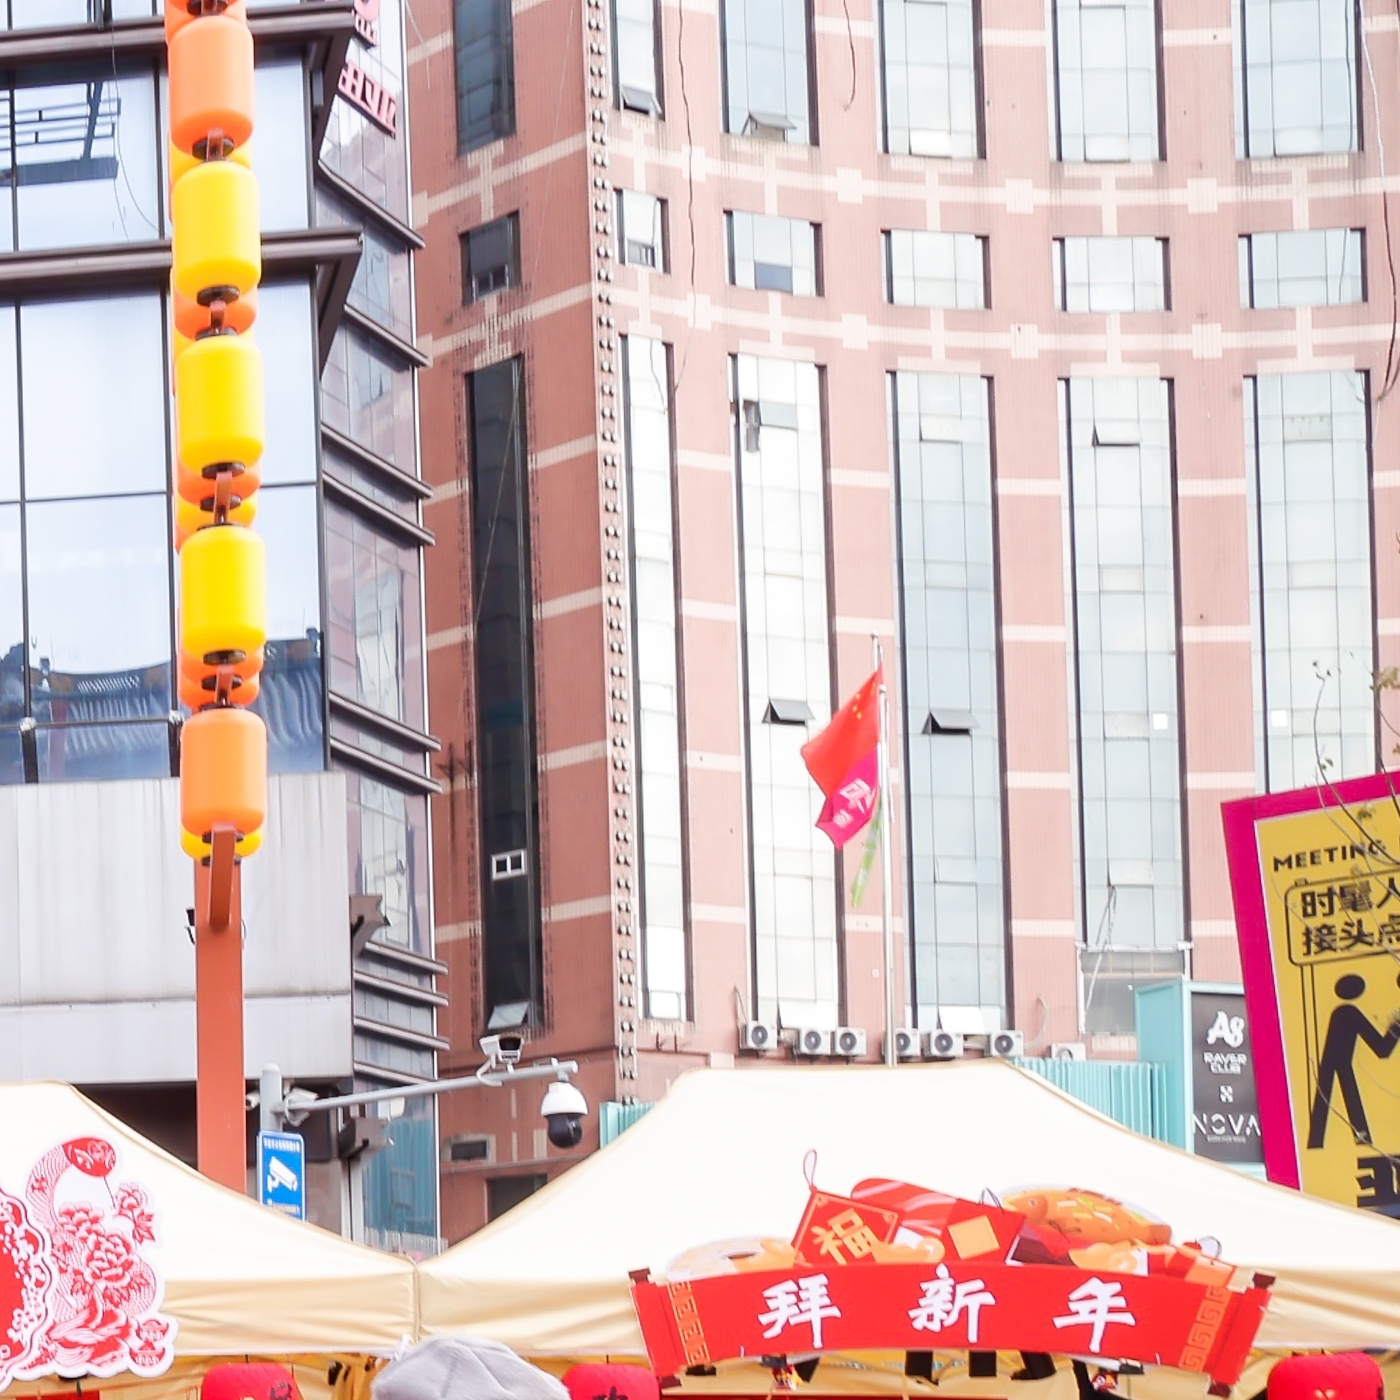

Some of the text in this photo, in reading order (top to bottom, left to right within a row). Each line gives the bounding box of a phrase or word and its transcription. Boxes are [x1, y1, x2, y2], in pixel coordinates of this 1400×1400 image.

[1207, 1011, 1245, 1048] A8
[1193, 1113, 1261, 1137] NOVA
[811, 1208, 879, 1266] 福
[758, 1263, 1136, 1353] 拜新年
